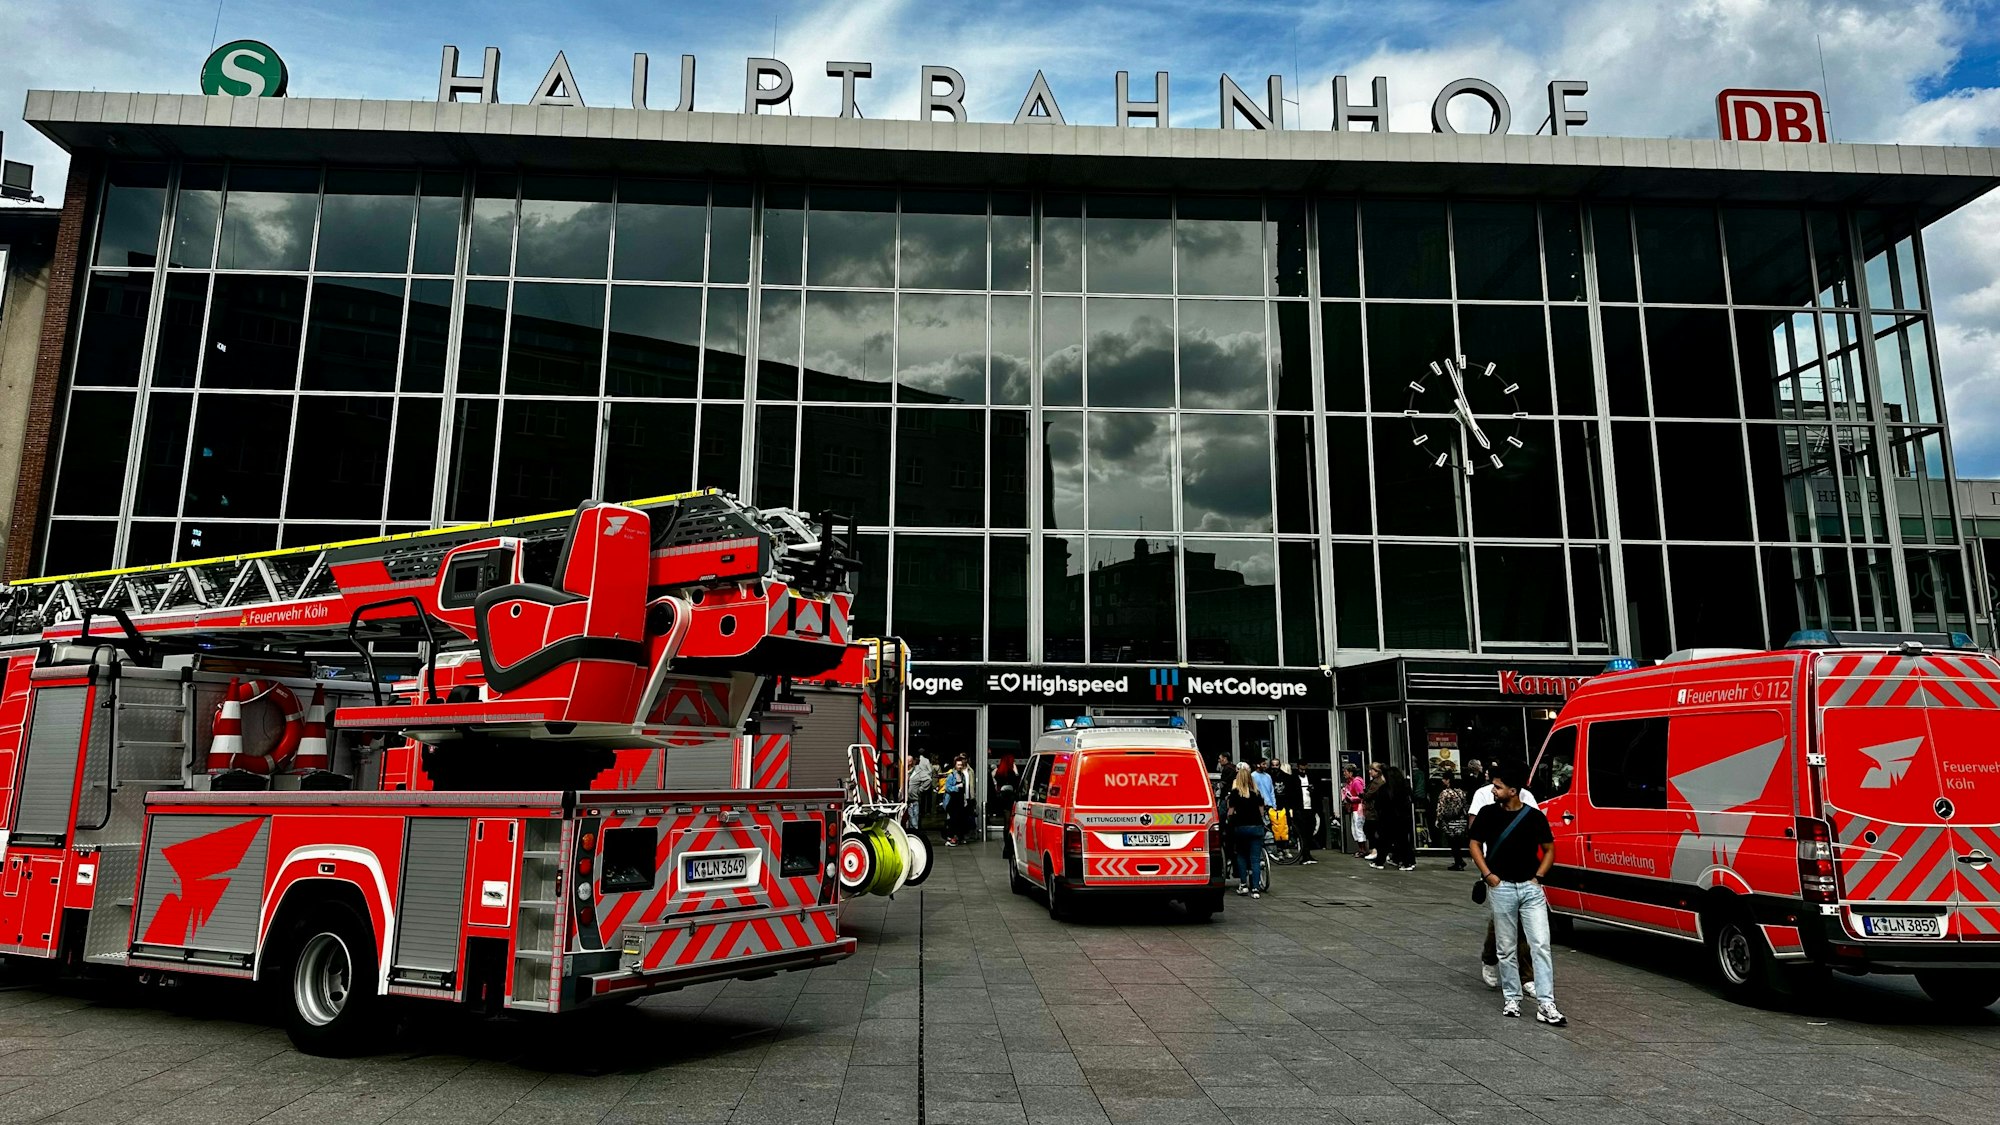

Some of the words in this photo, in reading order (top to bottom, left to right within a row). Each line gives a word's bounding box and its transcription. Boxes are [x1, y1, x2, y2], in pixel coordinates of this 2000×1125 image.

[218, 49, 265, 97] S
[438, 45, 1589, 136] HAUPTBAHNHOF
[1733, 100, 1813, 143] DB
[249, 604, 303, 624] Feuerwehr
[304, 603, 328, 619] Köln
[1022, 674, 1129, 697] Highspeed
[1187, 677, 1308, 700] NetCologne
[1498, 670, 1593, 701] Kamp
[1686, 682, 1749, 704] Feuerwehr
[1767, 680, 1790, 699] 112
[1104, 773, 1179, 787] NOTARZT
[1946, 777, 1975, 790] Köln
[1187, 813, 1206, 825] 112
[1150, 834, 1169, 843] 3951
[694, 862, 701, 877] K
[721, 859, 745, 875] 3649
[1593, 848, 1656, 874] Einsatzleitung
[1872, 918, 1882, 932] K
[1906, 919, 1937, 933] 3859
